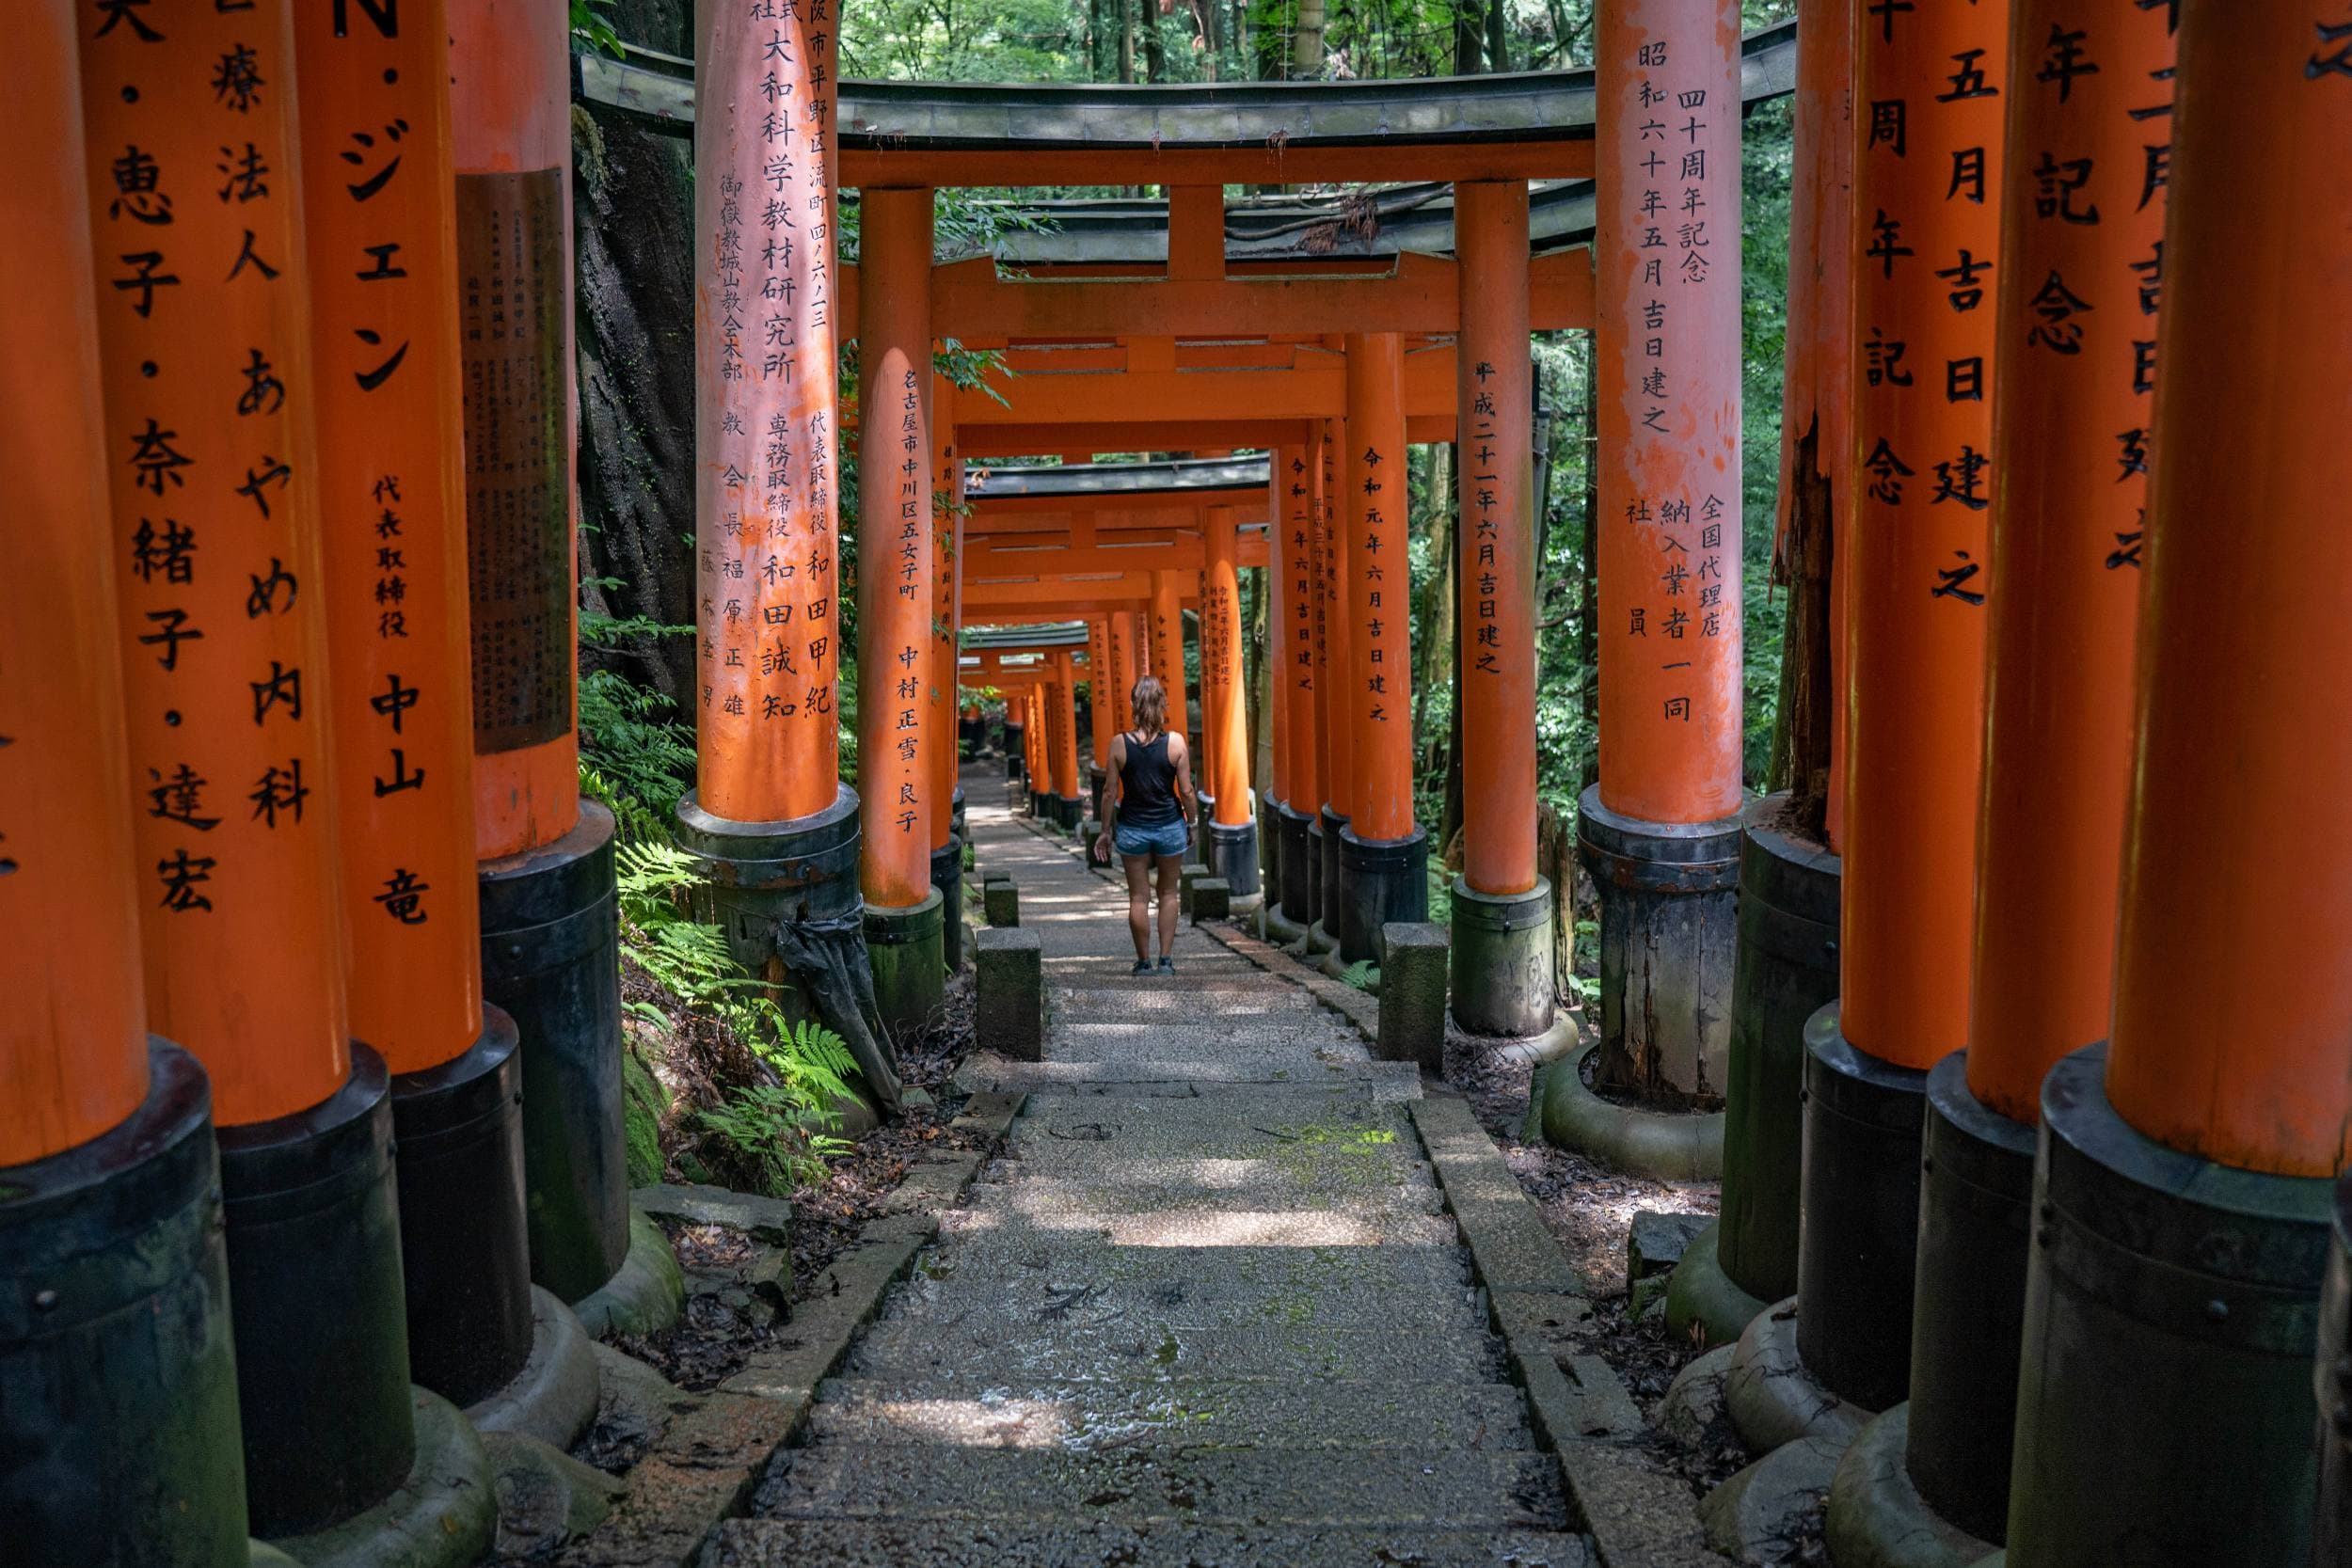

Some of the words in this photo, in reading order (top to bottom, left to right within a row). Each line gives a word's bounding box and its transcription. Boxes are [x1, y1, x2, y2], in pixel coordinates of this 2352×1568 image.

[212, 0, 280, 282] 療法人
[759, 29, 797, 385] 大和科学教材研究所
[1639, 41, 1670, 433] 昭和六十年五月吉日建之
[1677, 89, 1709, 284] 四十周年記念
[2029, 23, 2100, 356] 年記念
[1931, 0, 2000, 606] 五月吉日建之
[373, 475, 409, 640] 代表取締役
[766, 413, 792, 539] 専務取締役
[810, 412, 827, 535] 代表取締役
[899, 370, 919, 601] 名古屋市中川区五女子町
[1290, 457, 1313, 691] 令和二年六月吉日建之
[1363, 446, 1389, 723] 令和元年六月吉日建之
[1473, 361, 1502, 674] 平成二十一年六月吉日建之
[1698, 494, 1724, 639] 全国代理店
[235, 349, 310, 830] あやめ内科
[760, 553, 798, 721] 和田誠知
[804, 550, 831, 720] 和田甲紀
[371, 674, 425, 800] 中山
[373, 868, 431, 926] 竜
